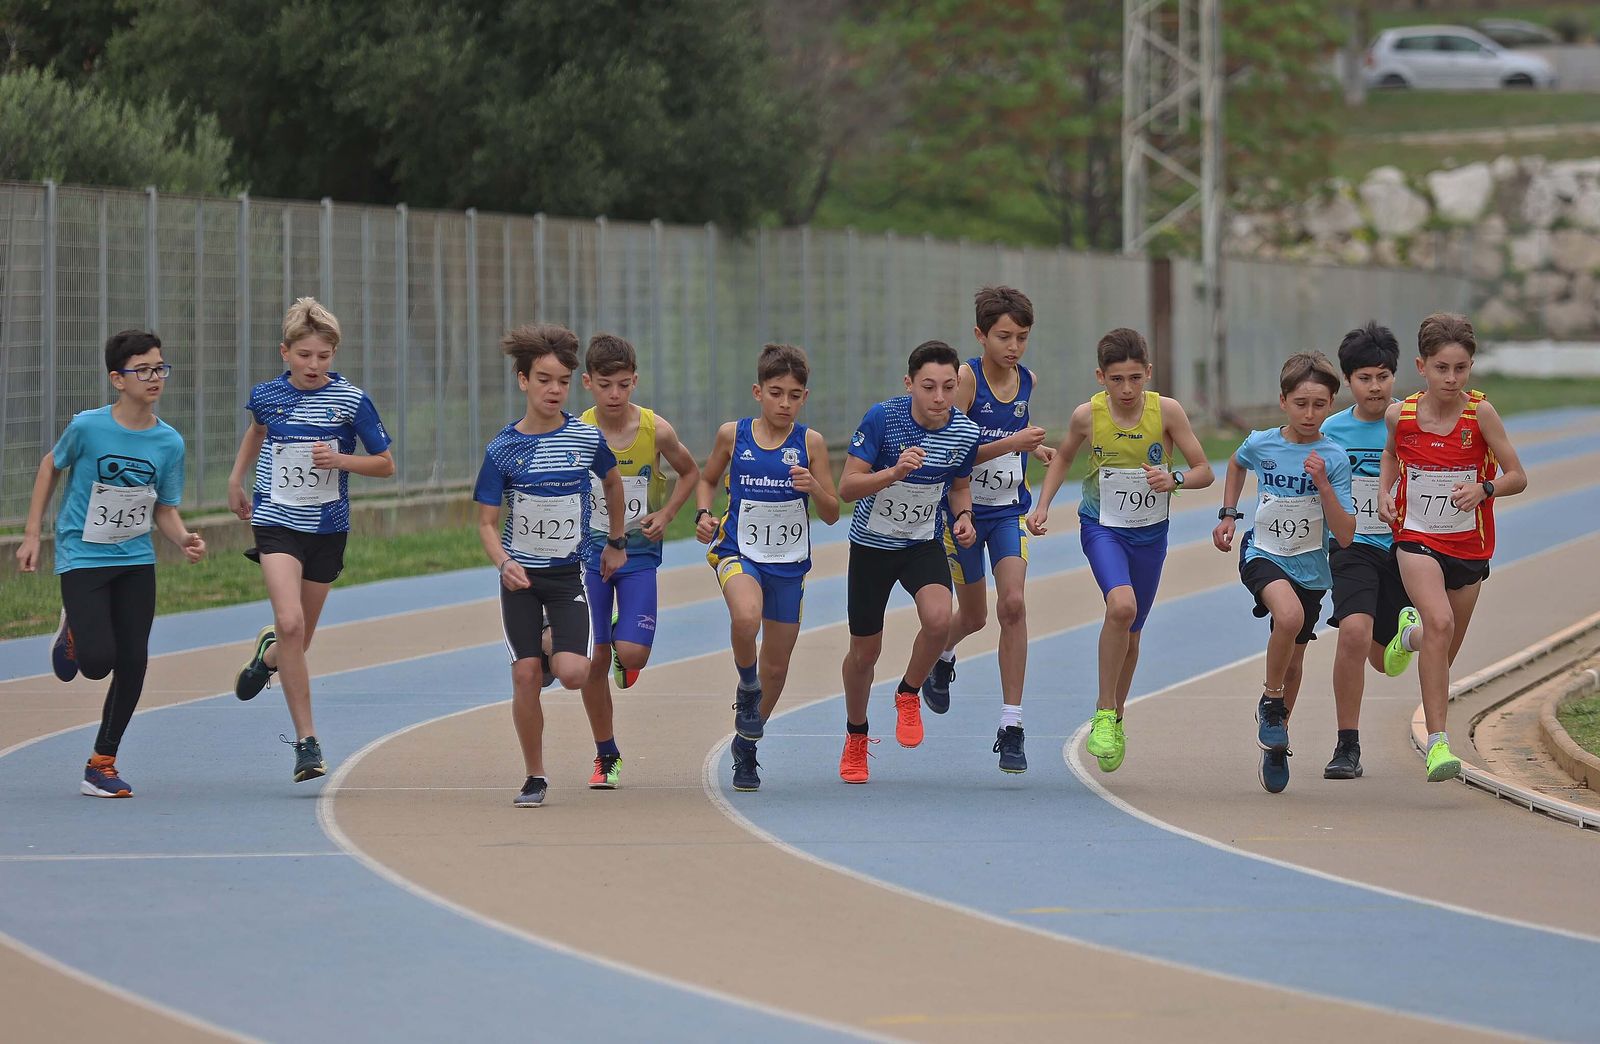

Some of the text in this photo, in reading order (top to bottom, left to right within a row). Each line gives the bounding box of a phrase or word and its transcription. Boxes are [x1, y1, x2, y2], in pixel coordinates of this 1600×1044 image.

[278, 466, 334, 488] 3357
[969, 468, 1014, 490] 451
[1263, 472, 1319, 495] nerja
[589, 493, 641, 520] 339
[879, 498, 934, 524] 3359
[1114, 489, 1157, 512] 796
[1351, 496, 1379, 518] 34
[93, 505, 147, 528] 3453
[518, 515, 575, 540] 3422
[745, 522, 803, 546] 3139
[1268, 518, 1310, 540] 493
